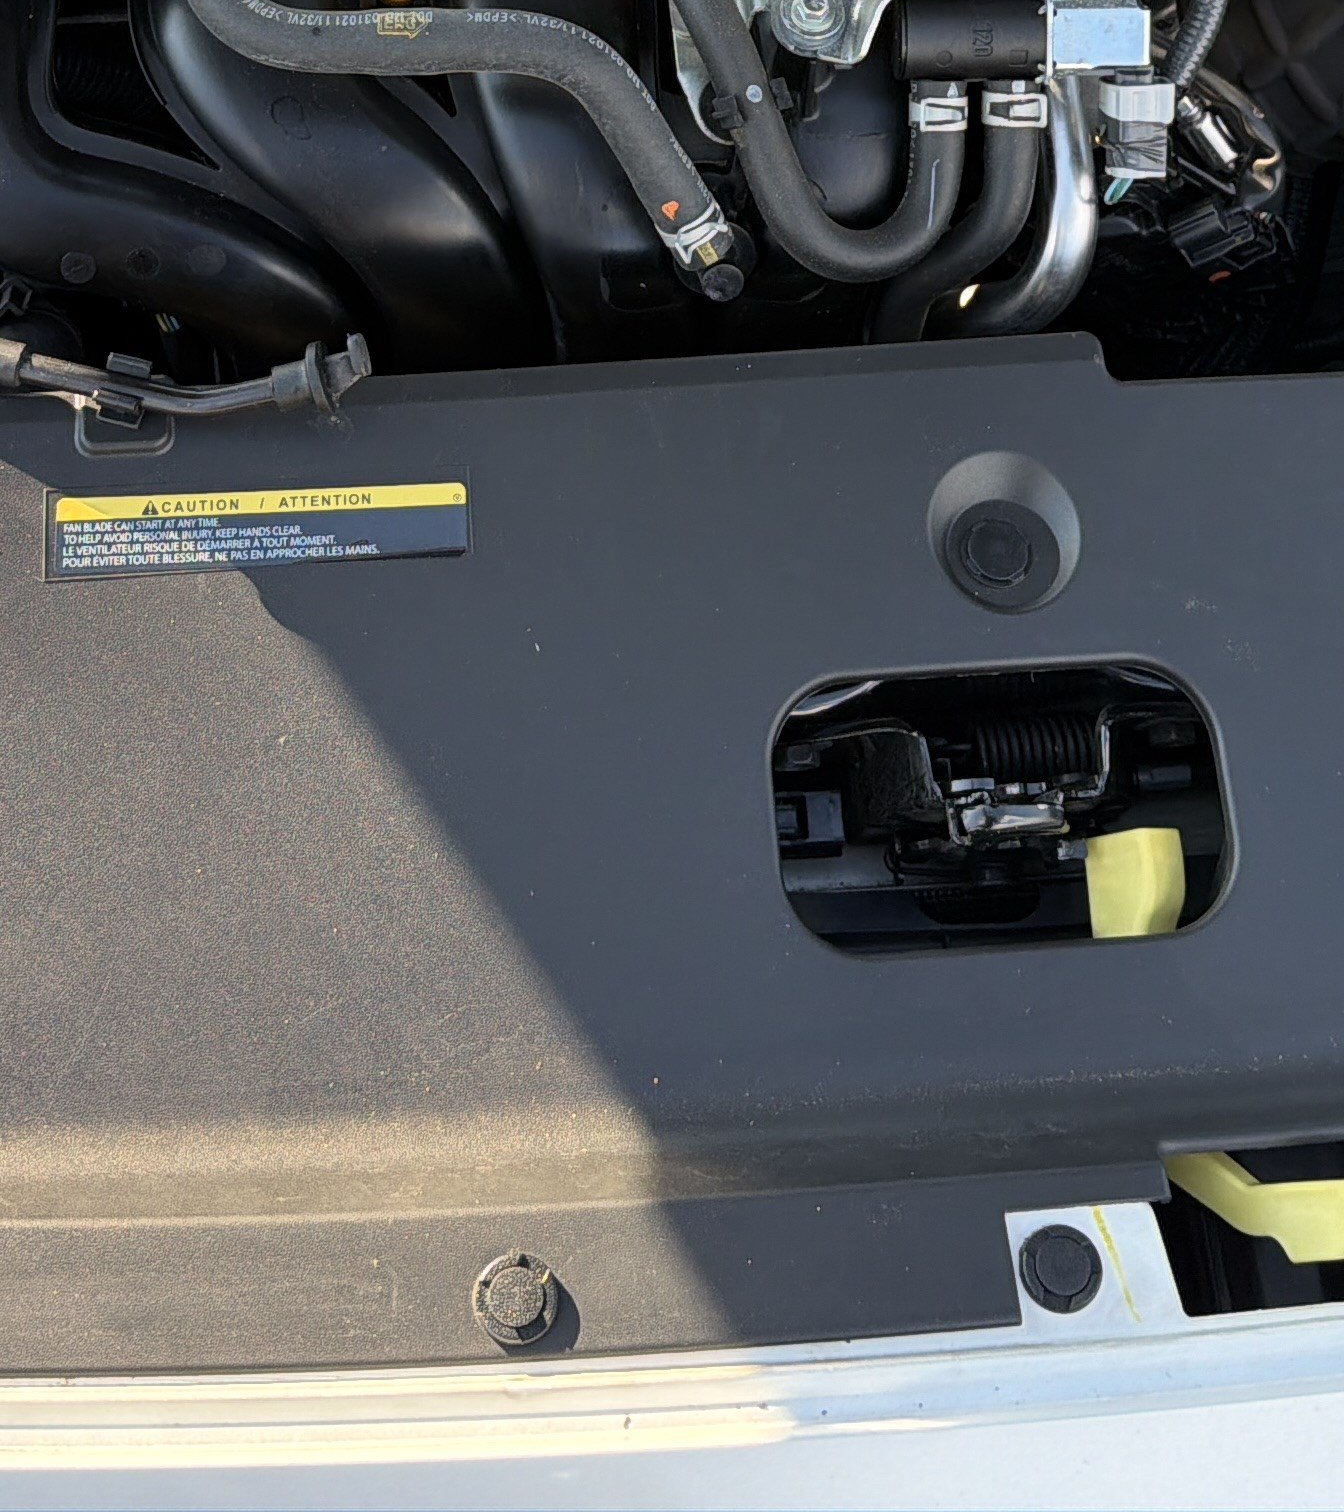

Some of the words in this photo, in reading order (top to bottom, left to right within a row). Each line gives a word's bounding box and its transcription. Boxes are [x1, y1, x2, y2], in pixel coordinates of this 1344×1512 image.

[161, 498, 240, 513] CAUTION
[278, 493, 372, 508] ATTENTION
[63, 522, 82, 533] FAN
[83, 521, 113, 533] BLADE
[114, 521, 135, 531] CAN
[135, 519, 163, 530] START
[164, 519, 175, 529] AT
[177, 519, 196, 528] ANY
[197, 517, 222, 528] TIME.
[63, 535, 77, 545] TO
[78, 533, 101, 544] HELP
[103, 532, 132, 543] AVOID
[132, 530, 181, 542] PERSONAL
[215, 528, 238, 538] KEEP
[239, 526, 271, 537] HANDS
[272, 524, 304, 536] CLEAR.
[62, 546, 75, 557] LE
[76, 544, 142, 556] VENTILATEUR
[143, 541, 180, 553] RISQUE
[182, 541, 196, 551] DE
[197, 538, 251, 550] DÉMARRER
[262, 537, 289, 548] TOUT
[290, 534, 337, 547] MOMENT.
[62, 557, 91, 568] POUR
[93, 555, 126, 567] ÉVITER
[127, 553, 161, 565] TOUTE
[162, 551, 214, 564] BLESSURE,
[214, 551, 228, 562] NE
[230, 550, 248, 560] PAS
[250, 549, 264, 559] EN
[266, 546, 325, 558] APPROCHER
[326, 545, 344, 556] LES
[345, 544, 381, 555] MAINS.
